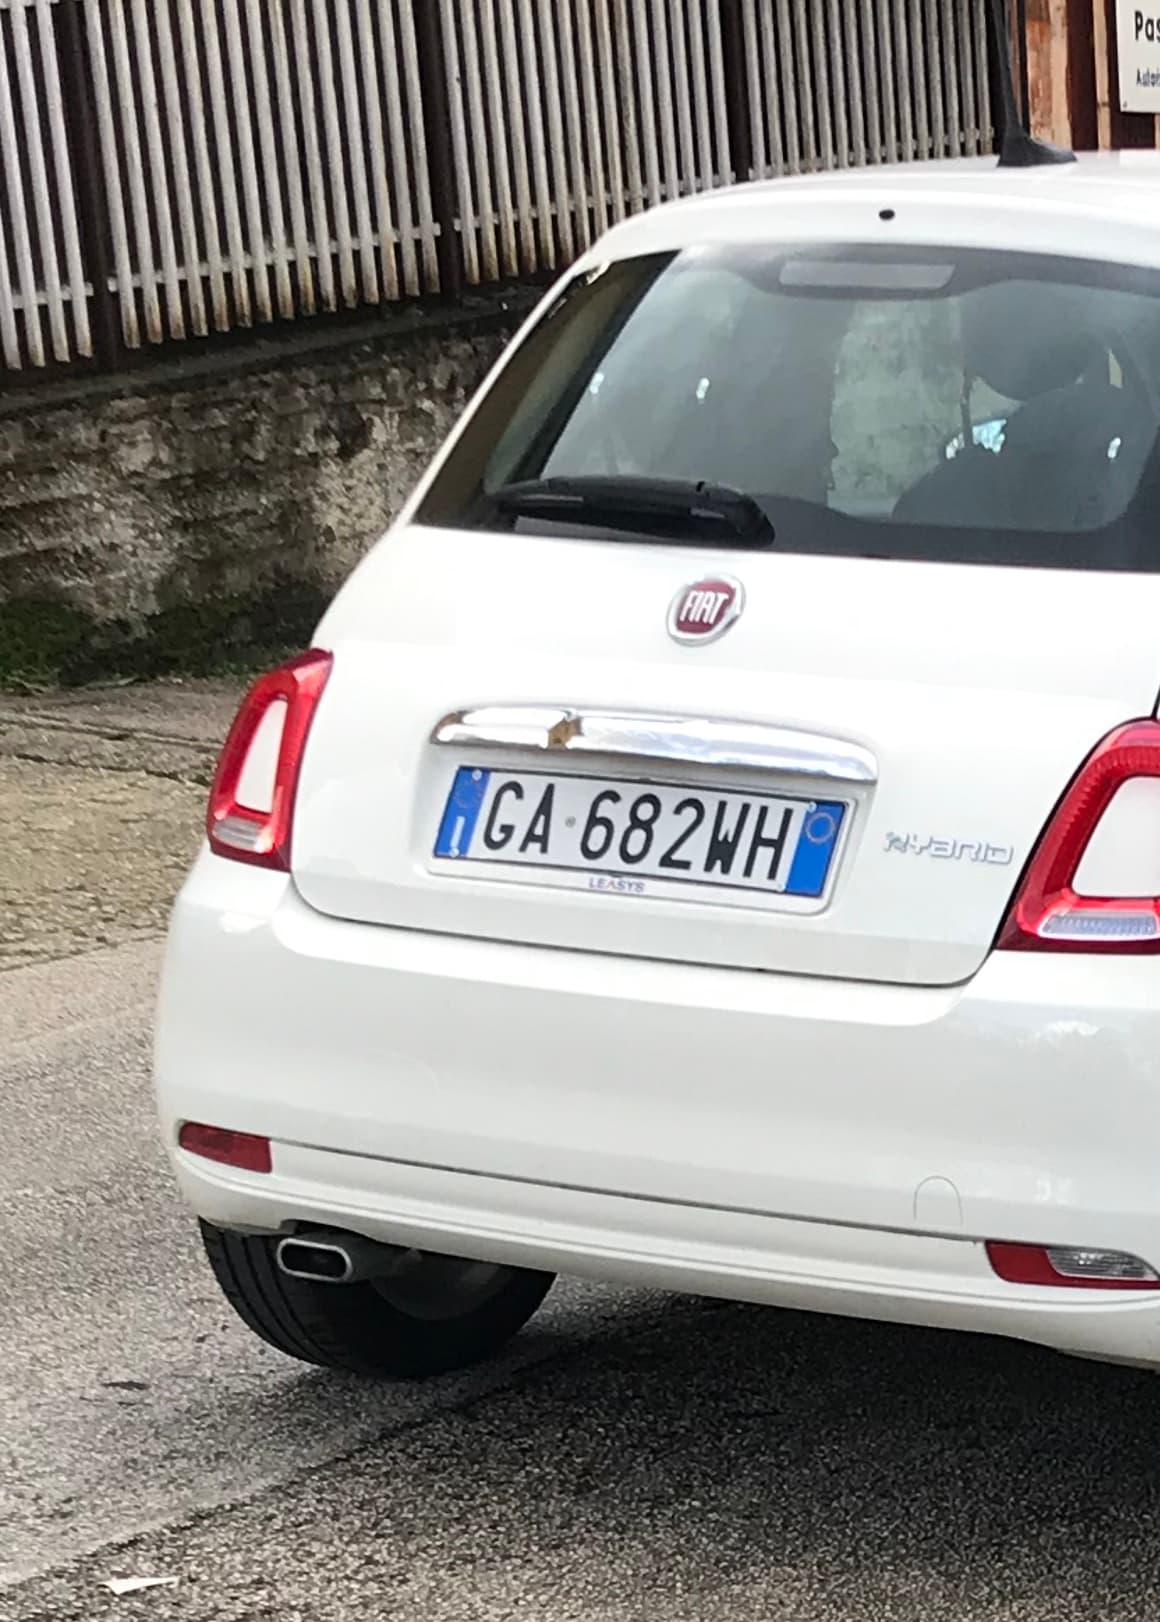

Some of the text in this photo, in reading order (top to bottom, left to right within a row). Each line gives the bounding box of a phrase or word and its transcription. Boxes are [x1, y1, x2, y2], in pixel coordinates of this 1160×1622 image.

[679, 590, 730, 624] FIAT
[483, 780, 794, 881] GA 682WH
[589, 877, 646, 893] LEASYS
